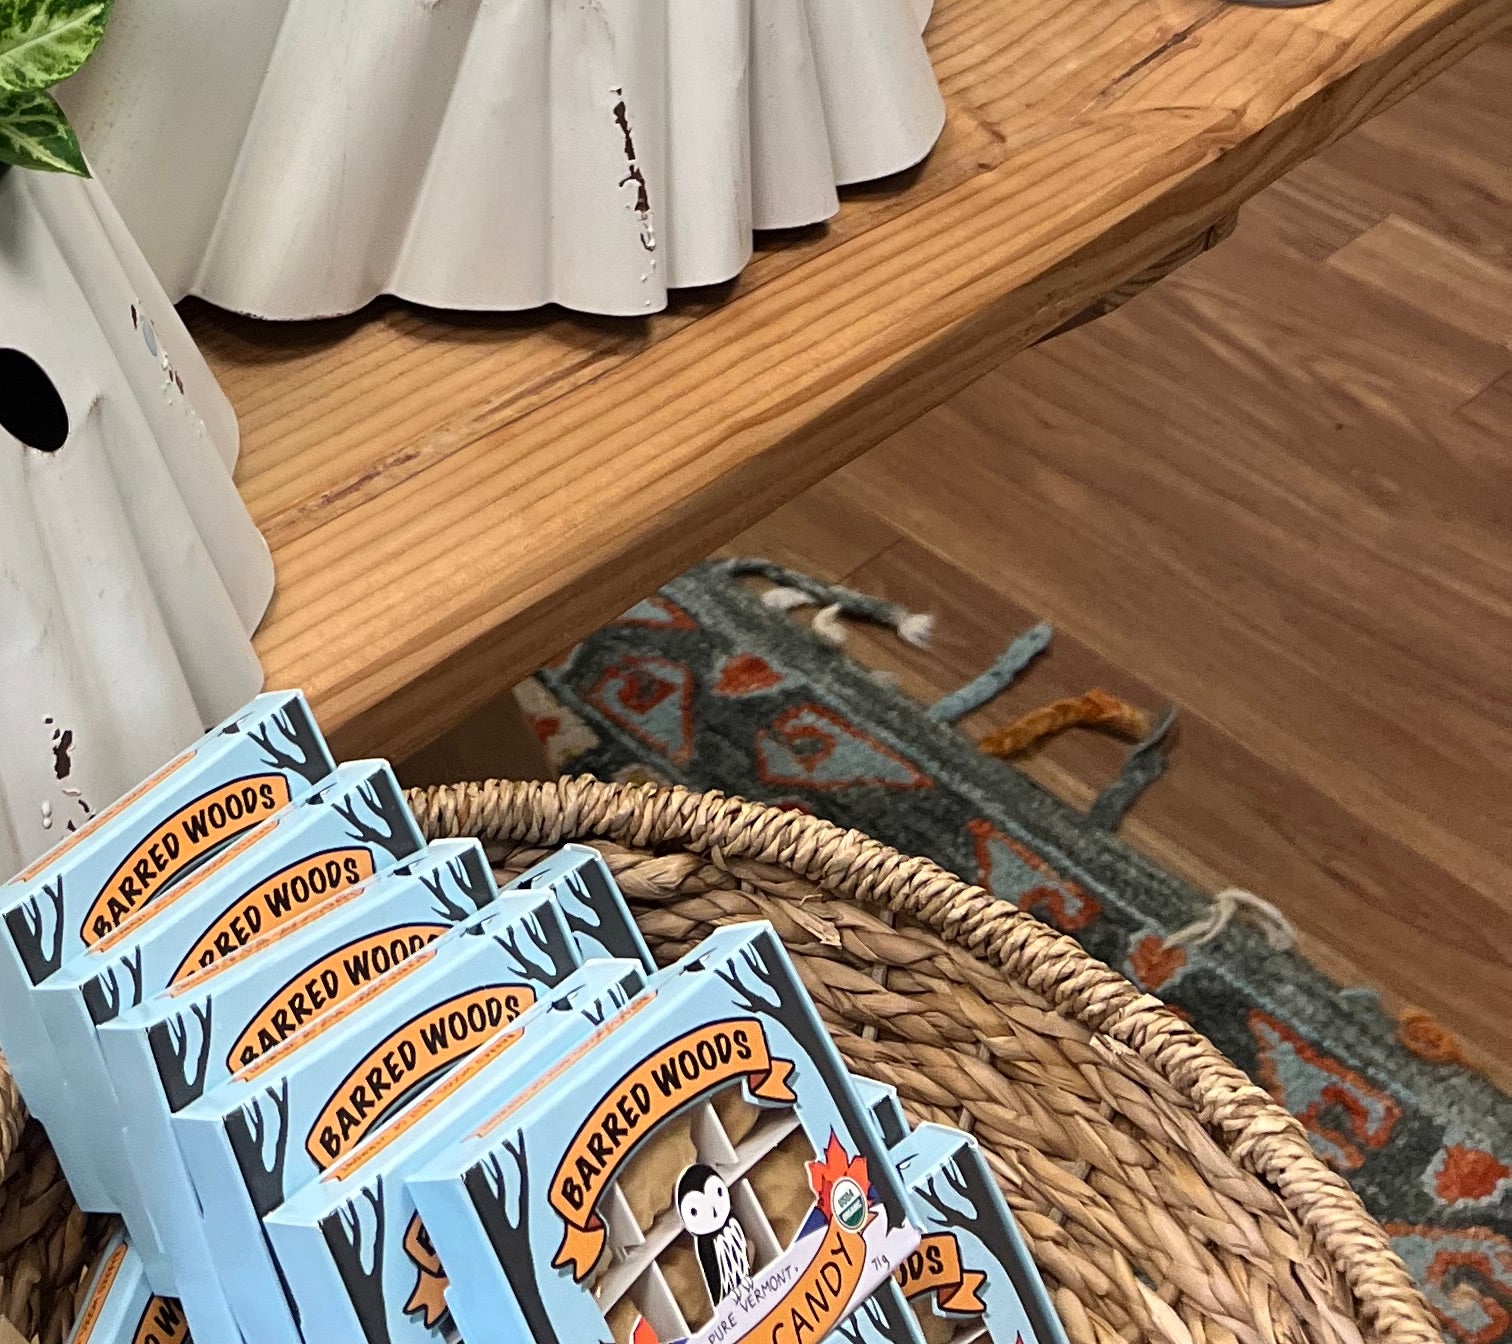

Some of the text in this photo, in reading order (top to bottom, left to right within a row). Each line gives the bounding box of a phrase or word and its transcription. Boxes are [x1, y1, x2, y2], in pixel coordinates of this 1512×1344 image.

[92, 782, 277, 940] BARRED WOODS
[187, 856, 360, 976] RRED WOODS
[239, 968, 340, 1069] BARRED
[318, 993, 521, 1159] BARRED WOODS
[560, 1028, 752, 1212] BARRED WOODS
[707, 1313, 739, 1344] PURE
[771, 1232, 855, 1344] CANDY
